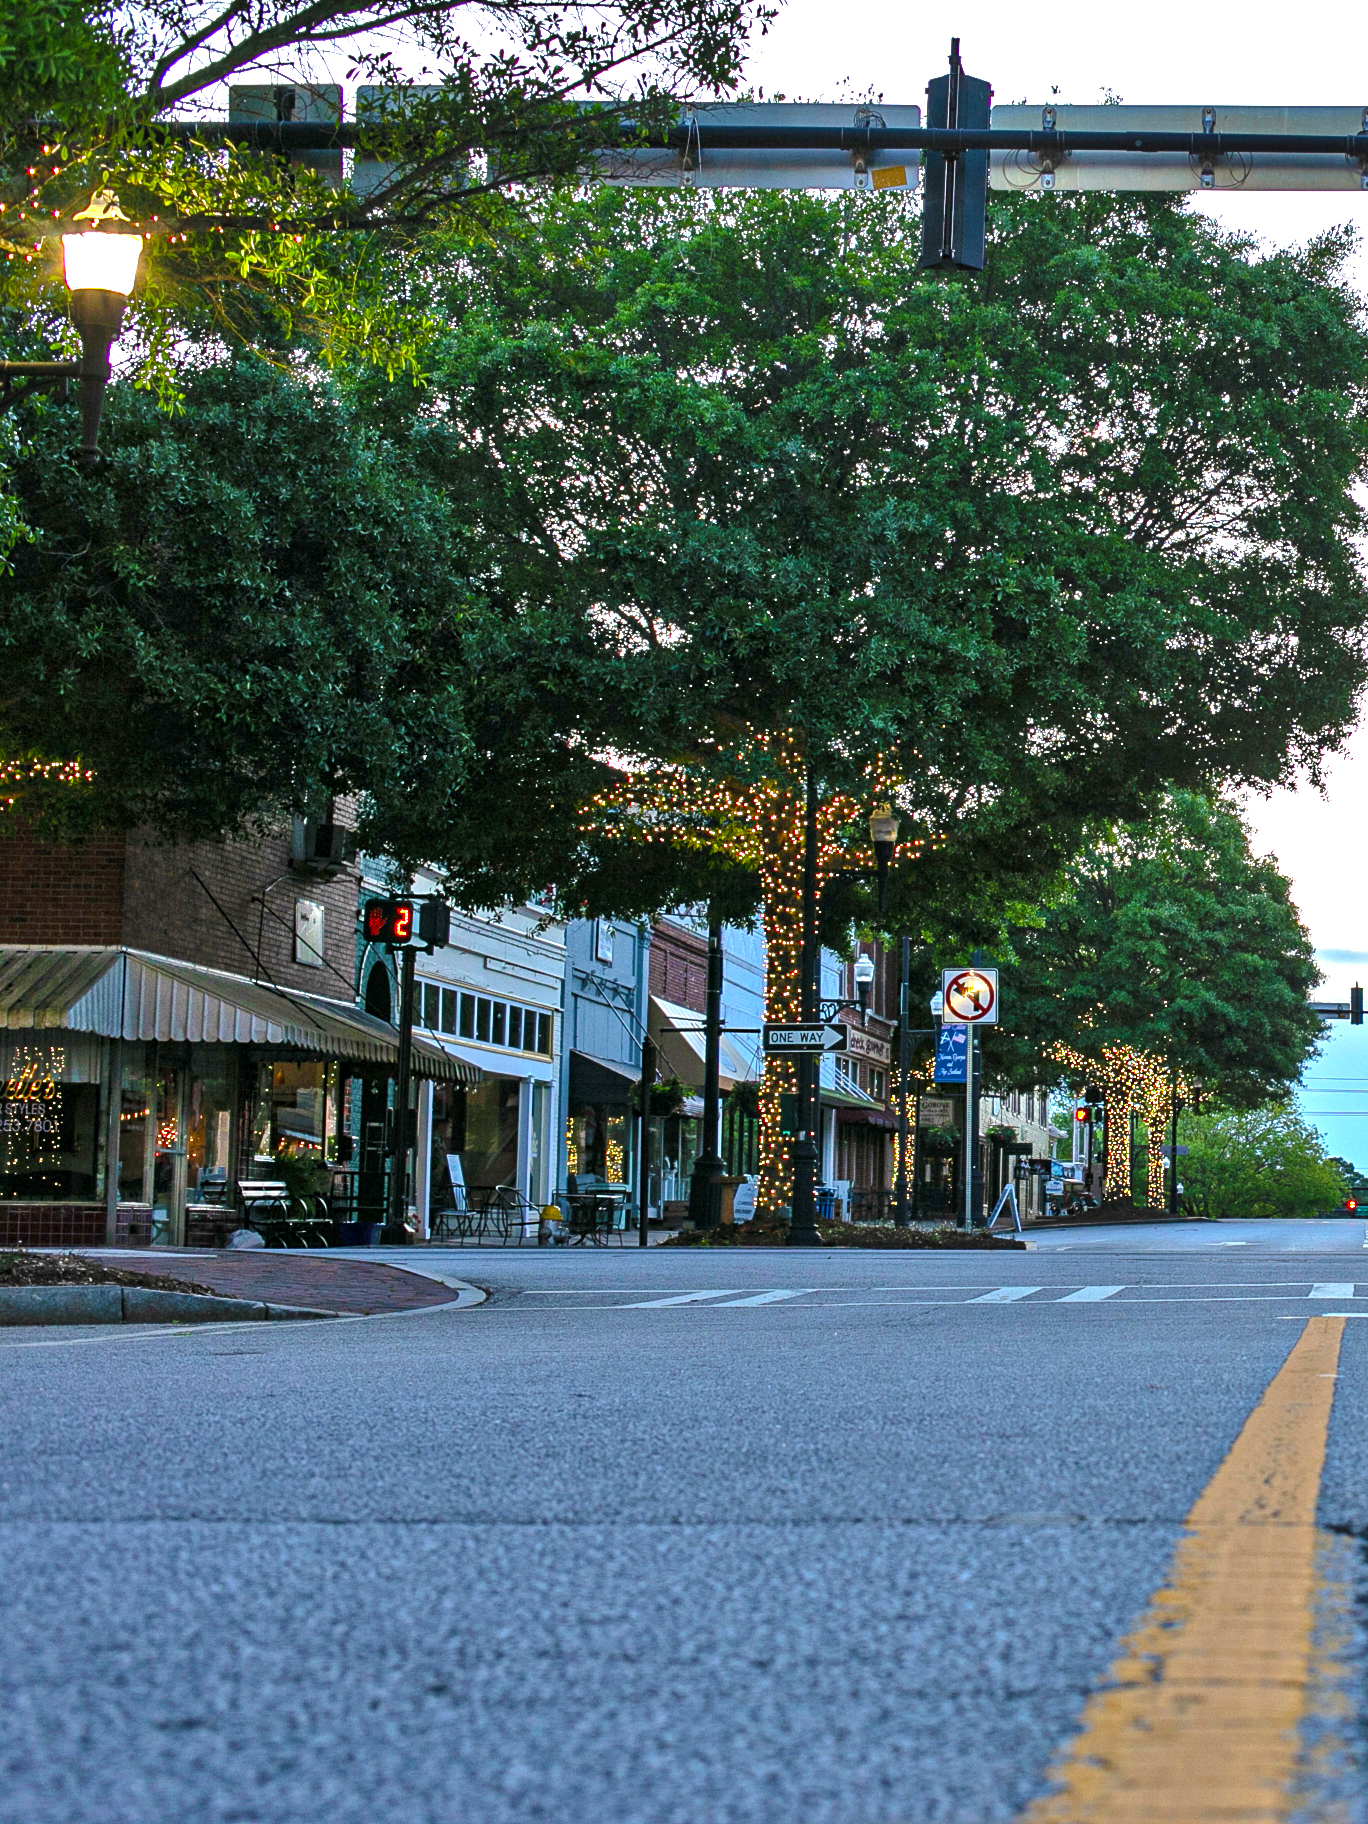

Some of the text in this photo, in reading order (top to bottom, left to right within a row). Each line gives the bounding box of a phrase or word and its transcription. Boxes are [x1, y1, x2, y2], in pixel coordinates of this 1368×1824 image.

[395, 907, 409, 936] 2
[770, 1032, 824, 1043] ONE WAY
[5, 1102, 46, 1116] STYLES
